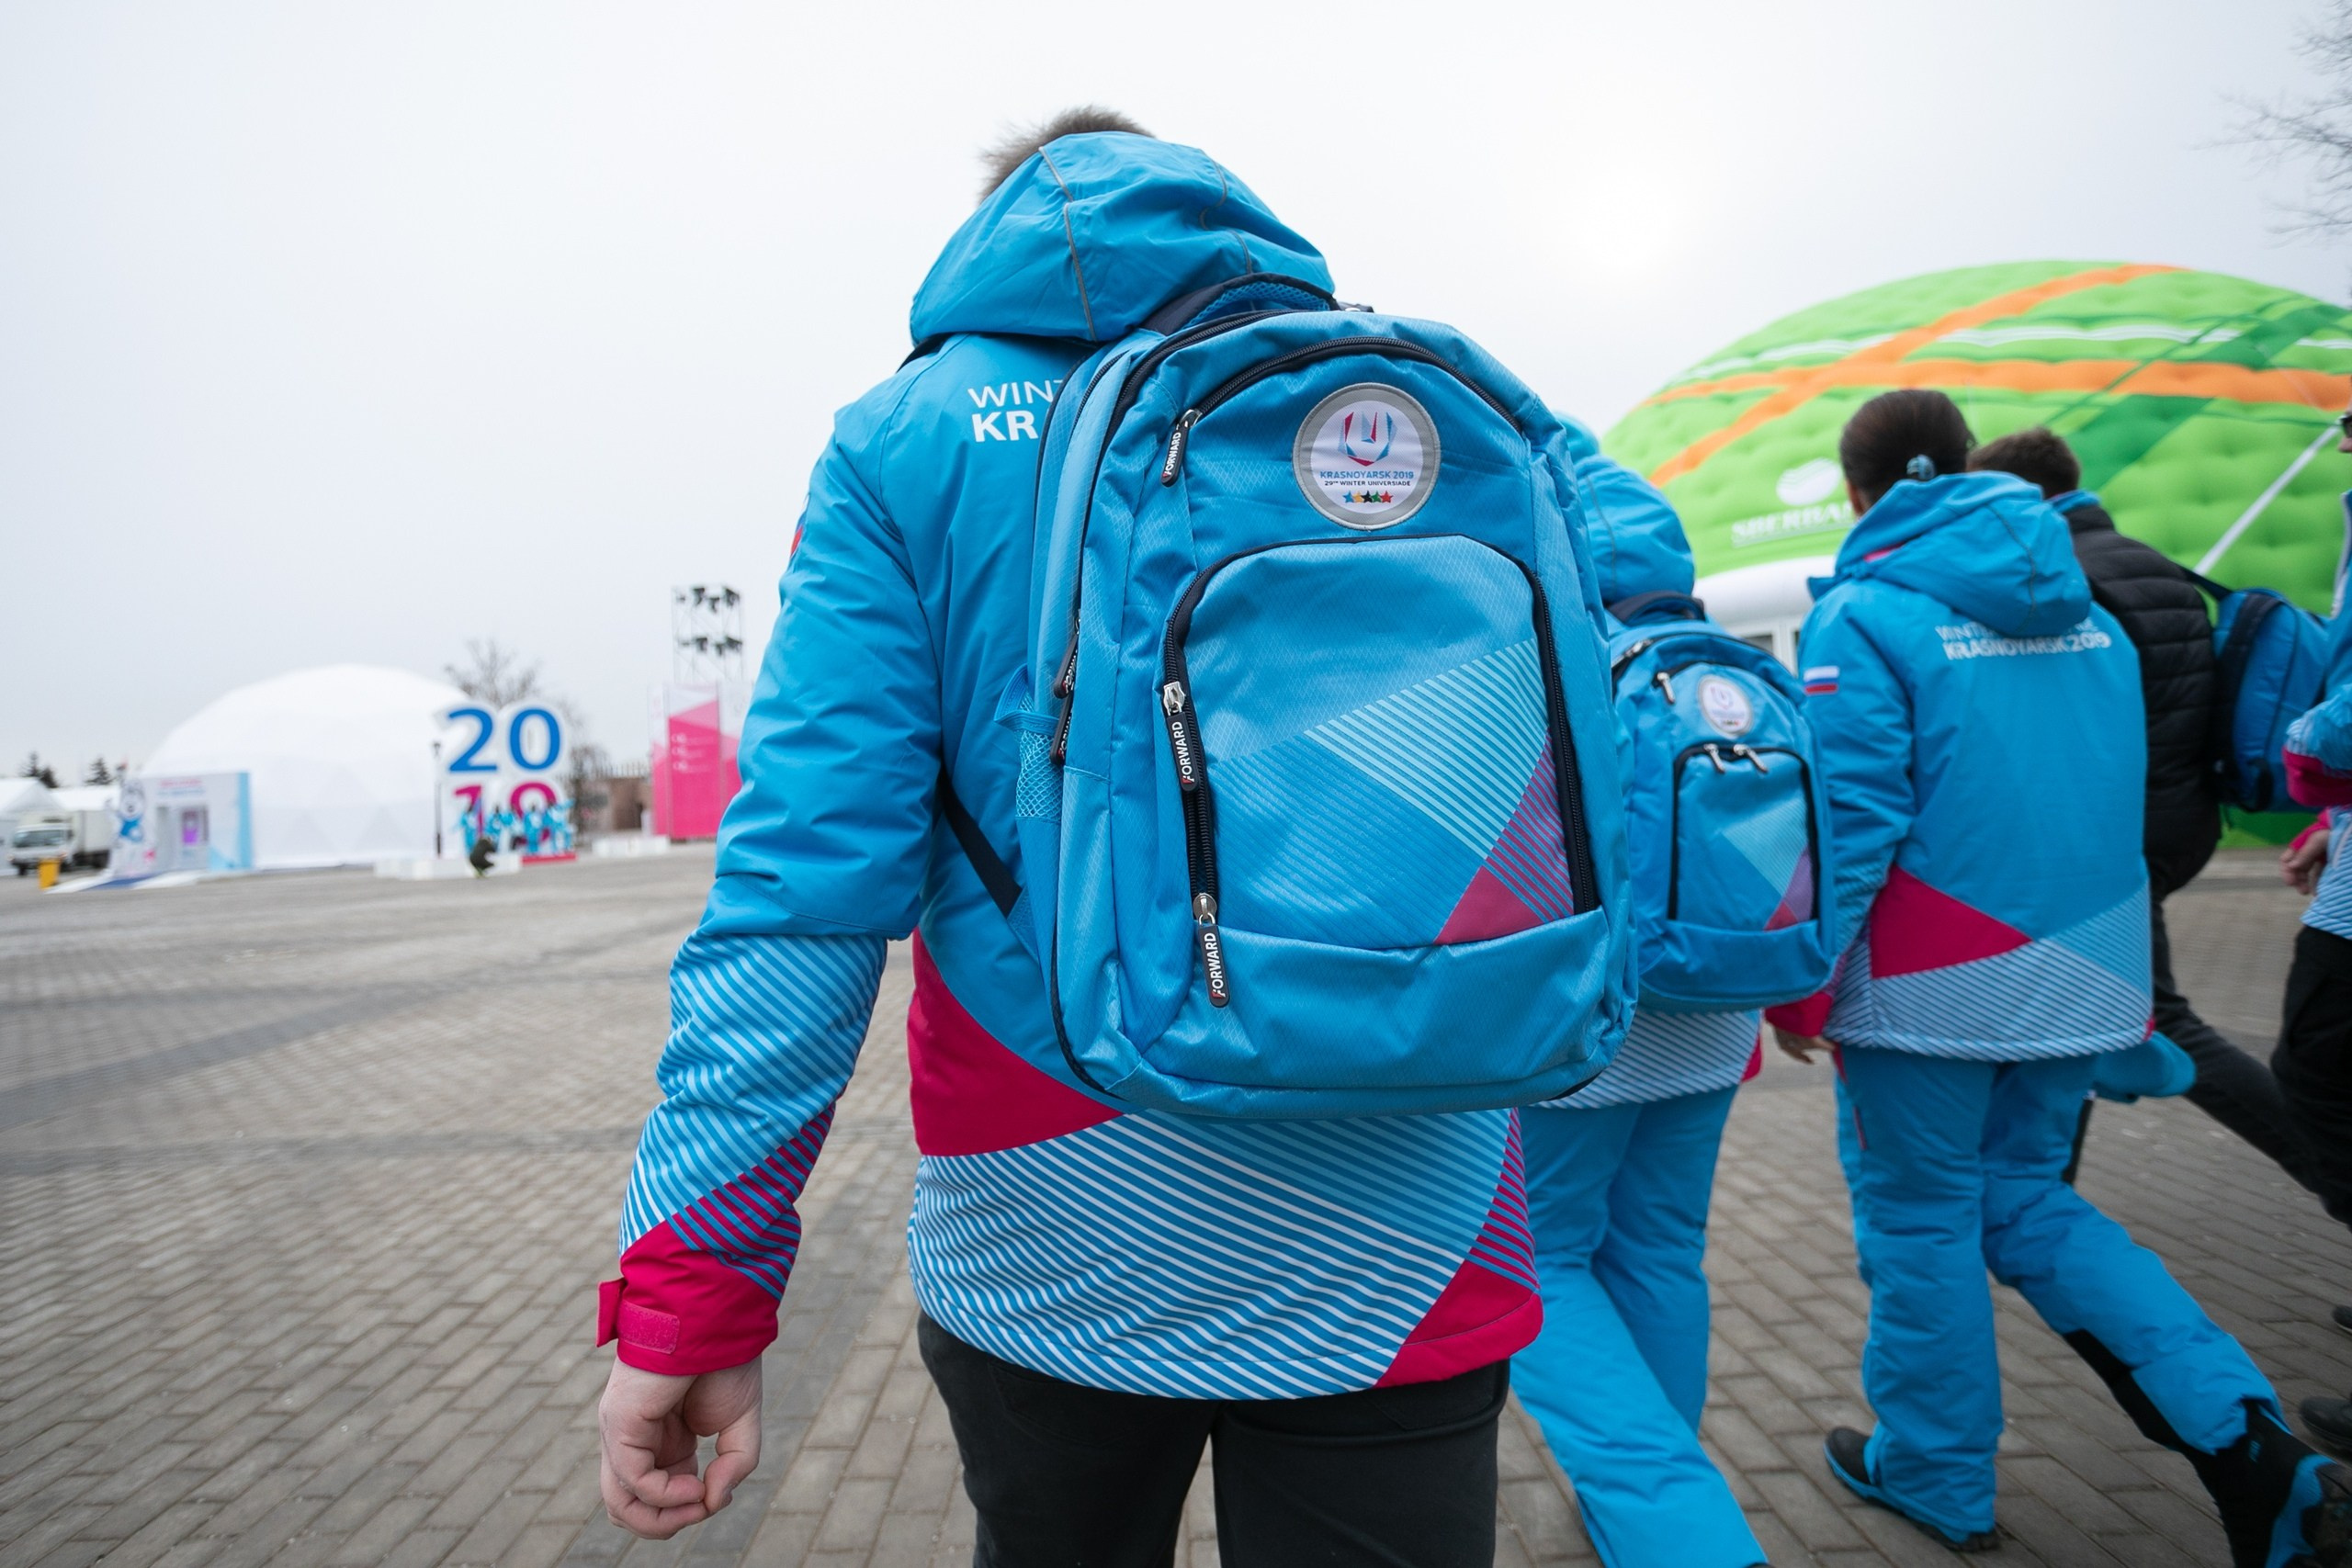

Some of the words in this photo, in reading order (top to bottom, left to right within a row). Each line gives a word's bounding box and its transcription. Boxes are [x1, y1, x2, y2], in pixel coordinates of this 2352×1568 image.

[1163, 432, 1182, 478] FORWARD
[1319, 470, 1391, 479] KRASNOYARSK
[1392, 470, 1415, 479] 2019
[447, 707, 561, 773] 20
[1171, 721, 1195, 784] FORWARD
[1204, 932, 1227, 1000] FORWARD
